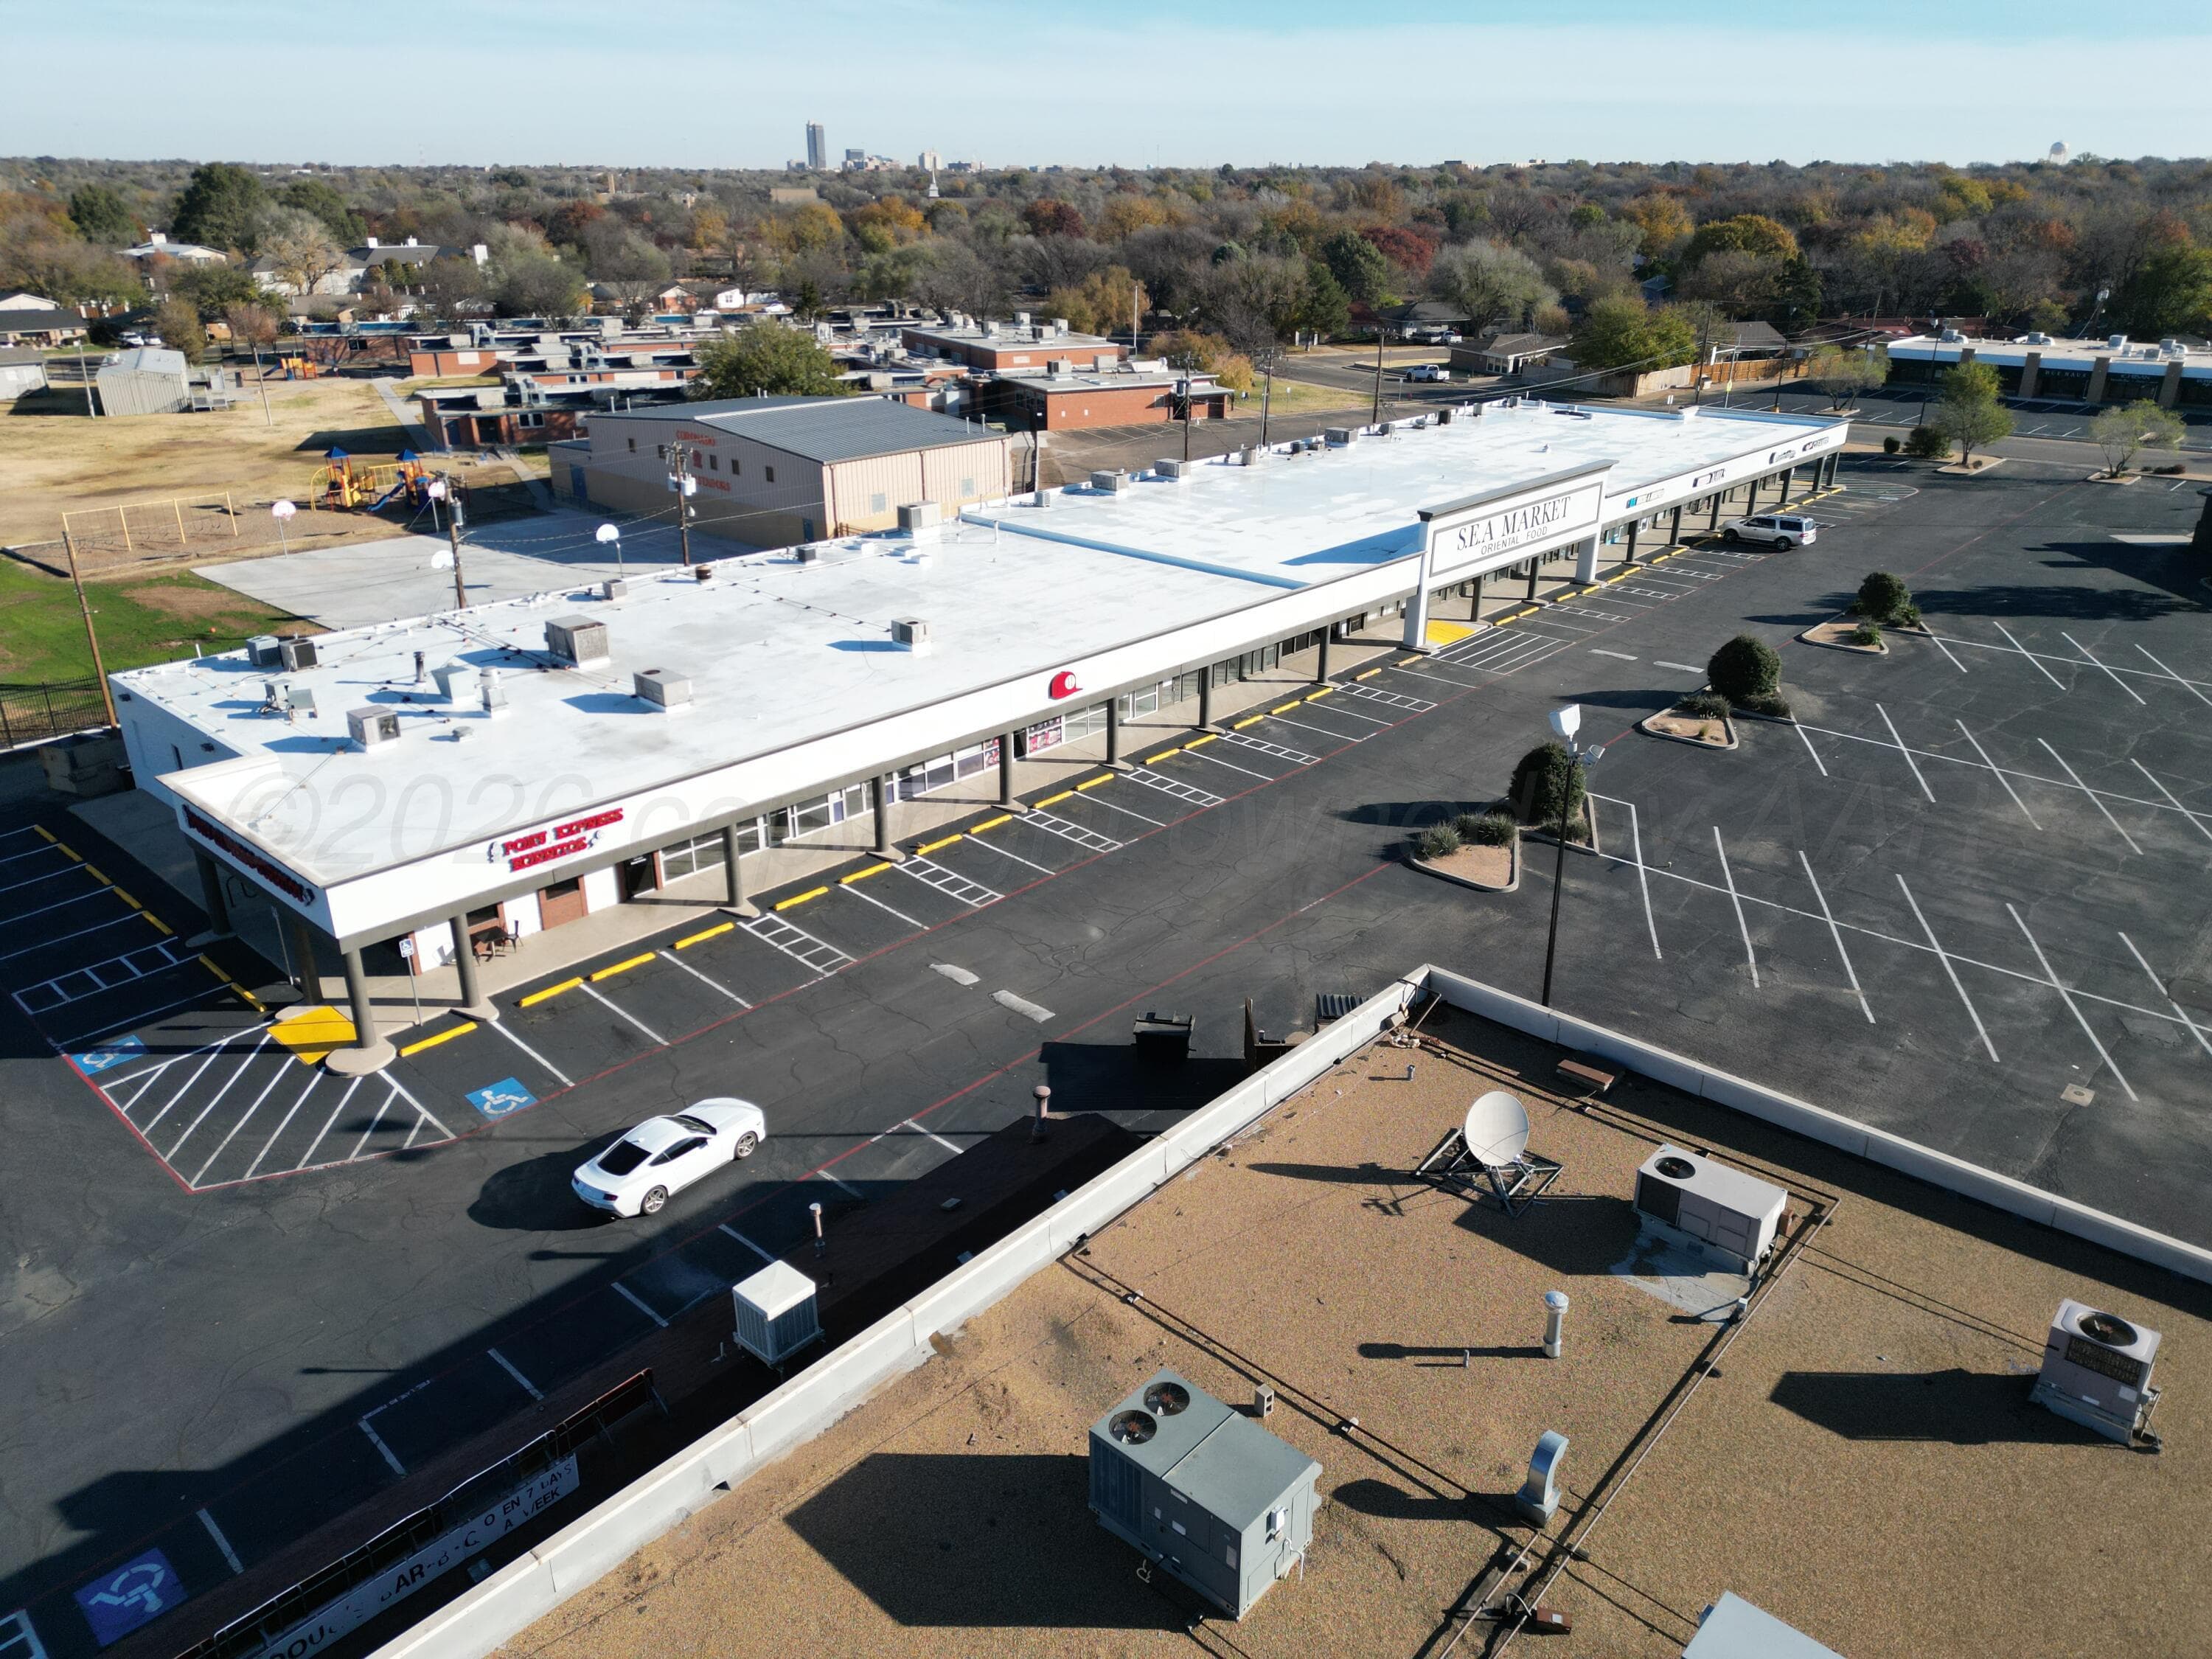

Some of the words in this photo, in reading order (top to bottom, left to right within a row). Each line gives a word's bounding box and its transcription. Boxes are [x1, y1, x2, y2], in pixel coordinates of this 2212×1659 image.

[1501, 496, 1571, 537] MARKET
[1481, 535, 1520, 555] ORIENTAL
[1526, 526, 1548, 540] FOOD
[553, 807, 624, 841] EXPRESS
[484, 1496, 520, 1526] OEN
[526, 1487, 533, 1498] 7
[504, 1518, 514, 1531] A
